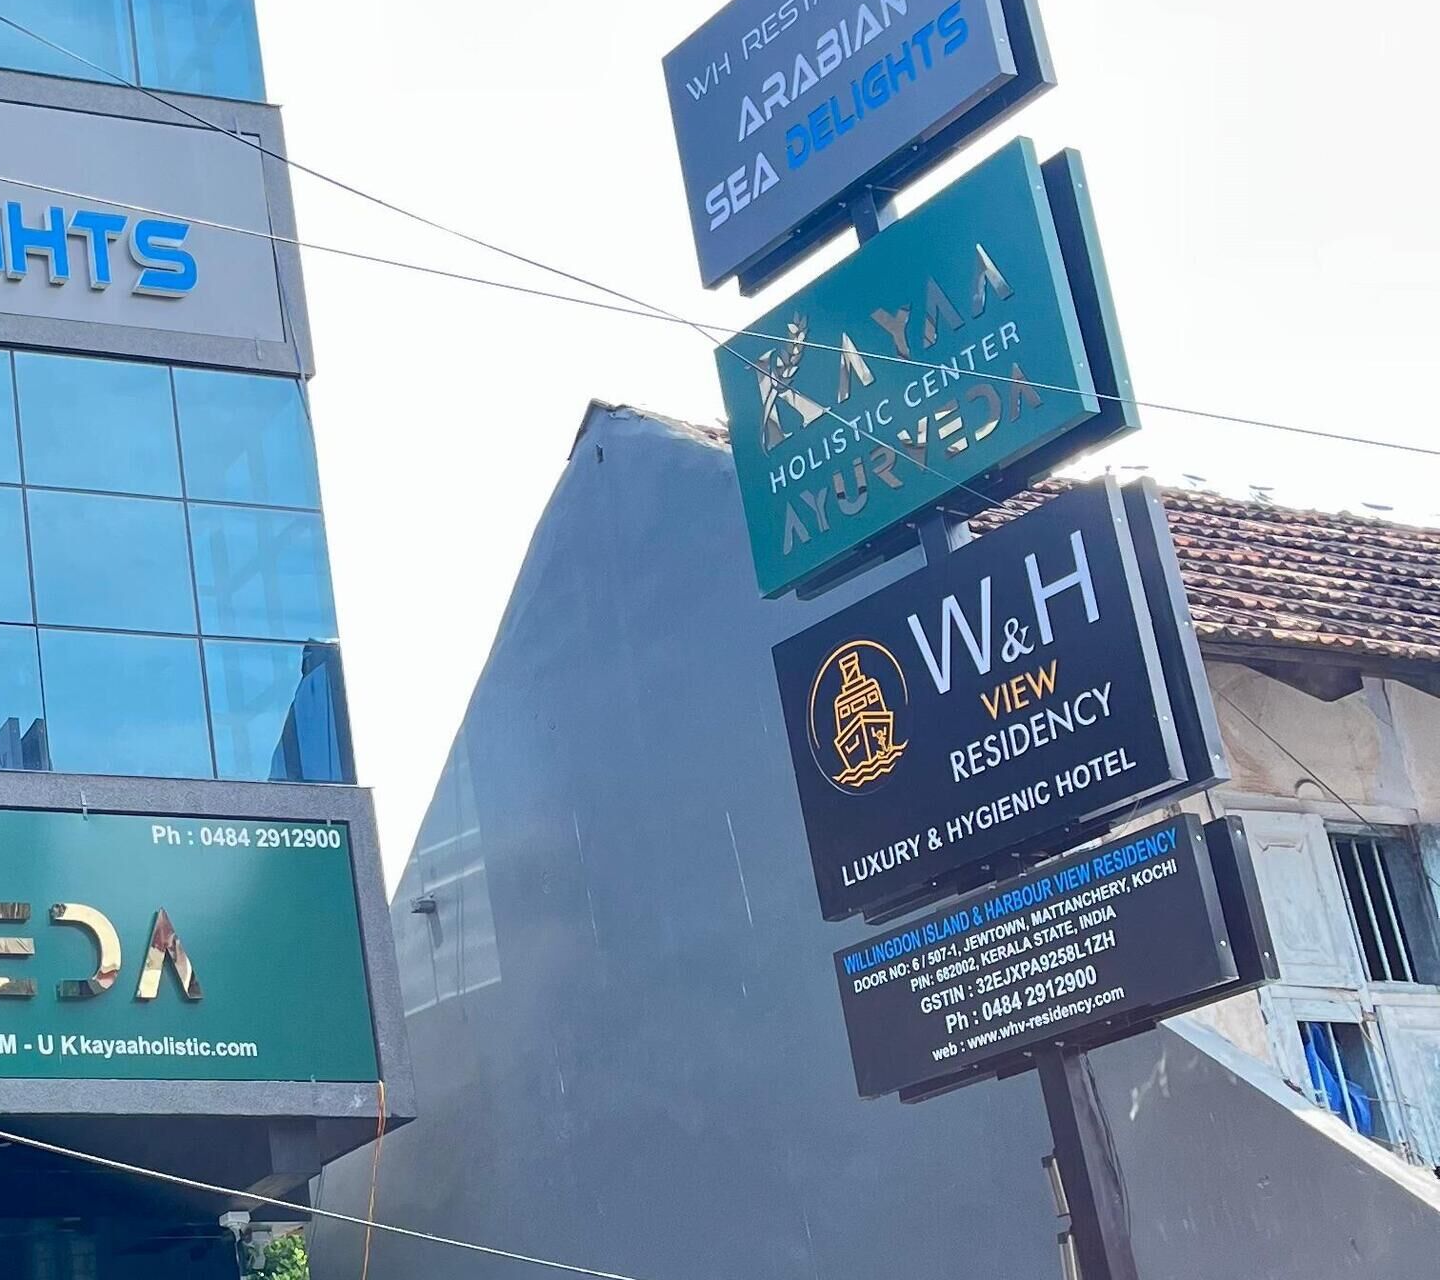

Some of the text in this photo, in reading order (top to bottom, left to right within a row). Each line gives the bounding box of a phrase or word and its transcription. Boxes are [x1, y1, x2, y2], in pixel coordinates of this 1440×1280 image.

[686, 51, 731, 102] WH
[705, 0, 970, 232] SEA DELIGHTS
[769, 321, 1021, 494] HOLISTIC CENTER
[782, 362, 1042, 555] AYURVEDA
[907, 530, 1100, 695] W&H
[949, 682, 1112, 783] RESIDENCY
[980, 660, 1059, 721] VIEW
[152, 825, 181, 848] Ph
[199, 828, 251, 848] 0484
[256, 828, 341, 850] 2912900
[842, 746, 1137, 887] LUXURY & HYGIENIC HOTEL
[843, 827, 1178, 976] WILLINGDON ISLAND & HARBOUR VIEW RESIDENCY
[854, 970, 888, 994] DOOR
[912, 957, 920, 971] 6
[1132, 858, 1178, 889] KOCHI
[981, 936, 1033, 967] KERALA
[1079, 905, 1117, 930] INDIA
[920, 983, 965, 1014] GSTIN
[932, 1040, 958, 1061] web
[967, 985, 1125, 1049] www.whv-residency.com
[946, 1011, 969, 1034] Ph
[982, 991, 1022, 1021] 0484
[1025, 965, 1097, 1007] 2912900
